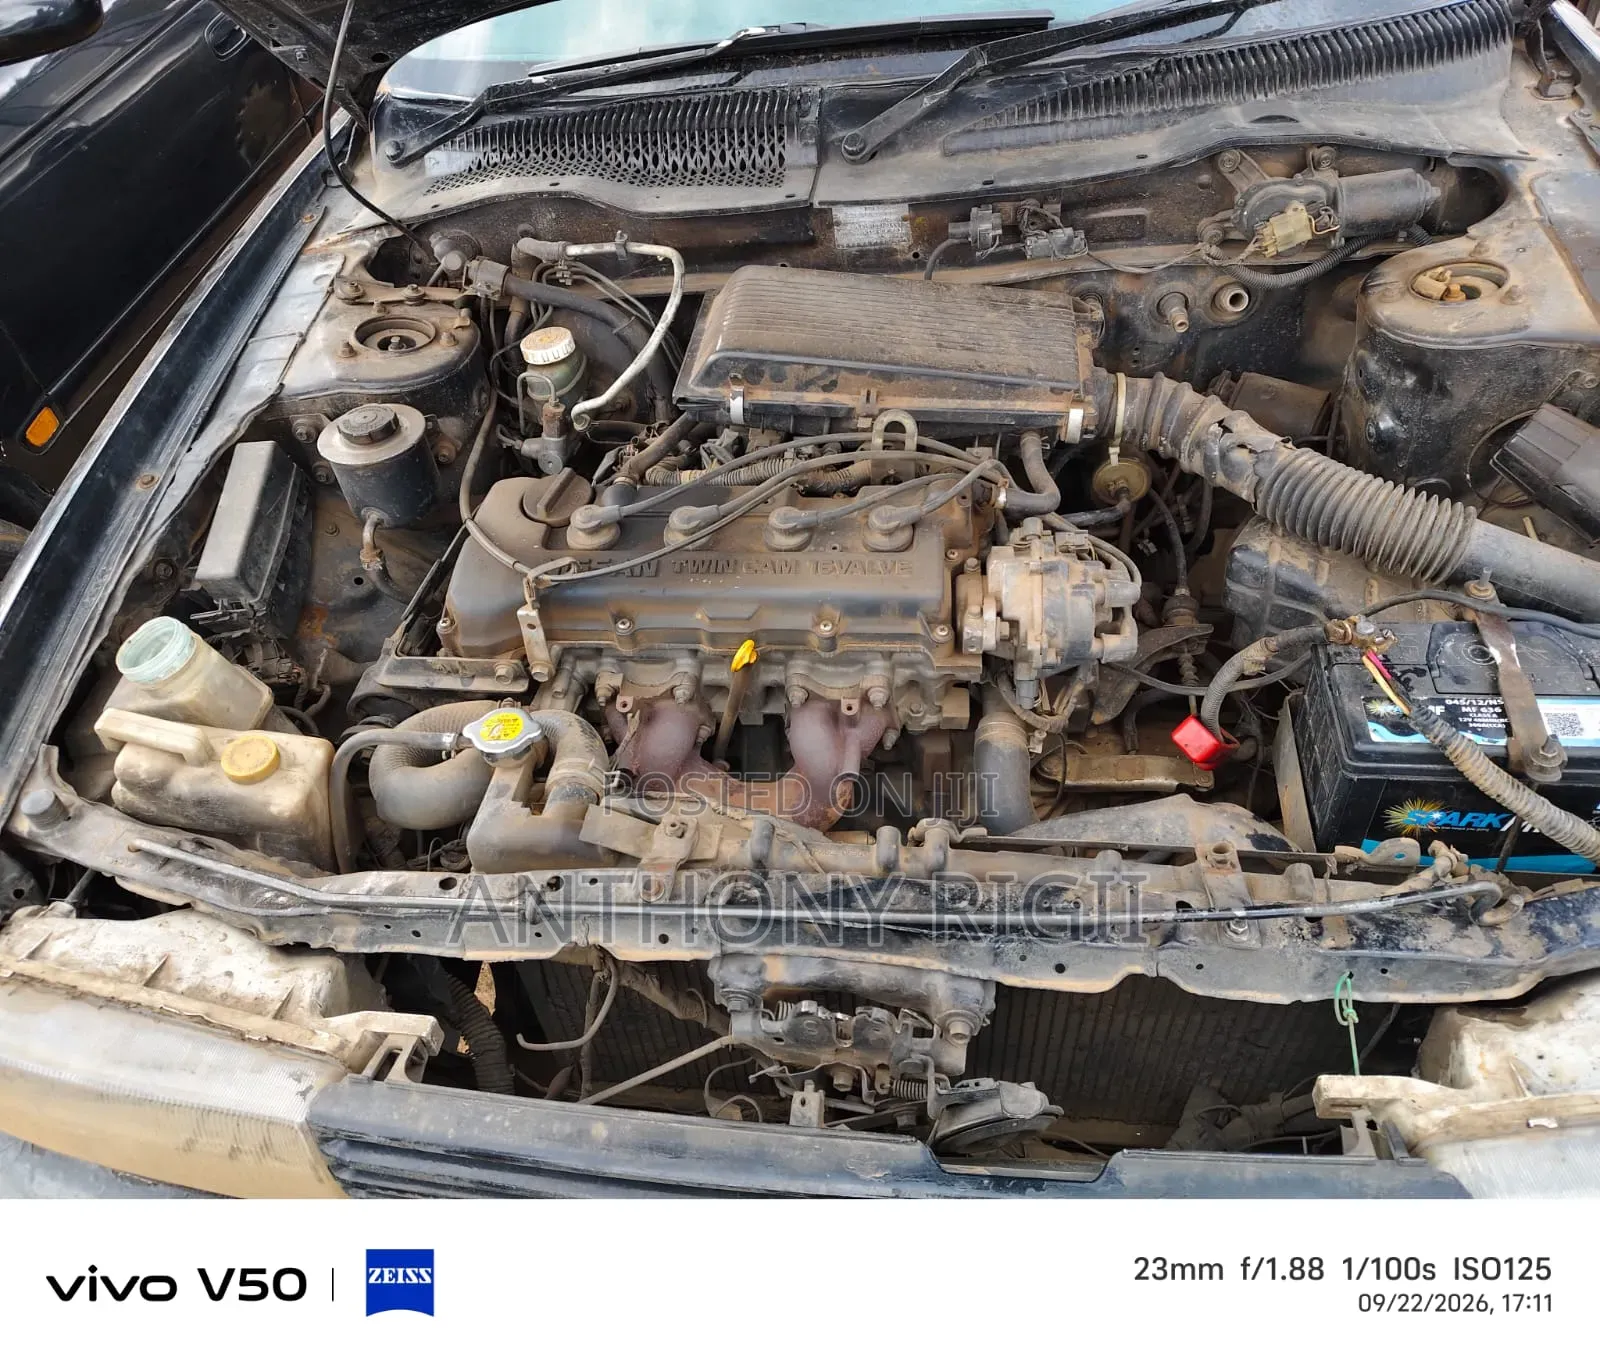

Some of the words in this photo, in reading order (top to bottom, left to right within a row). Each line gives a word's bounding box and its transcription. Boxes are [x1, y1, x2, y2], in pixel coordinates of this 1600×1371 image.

[671, 559, 737, 575] TWIN
[742, 559, 800, 576] CAM
[1404, 809, 1513, 827] SPARK
